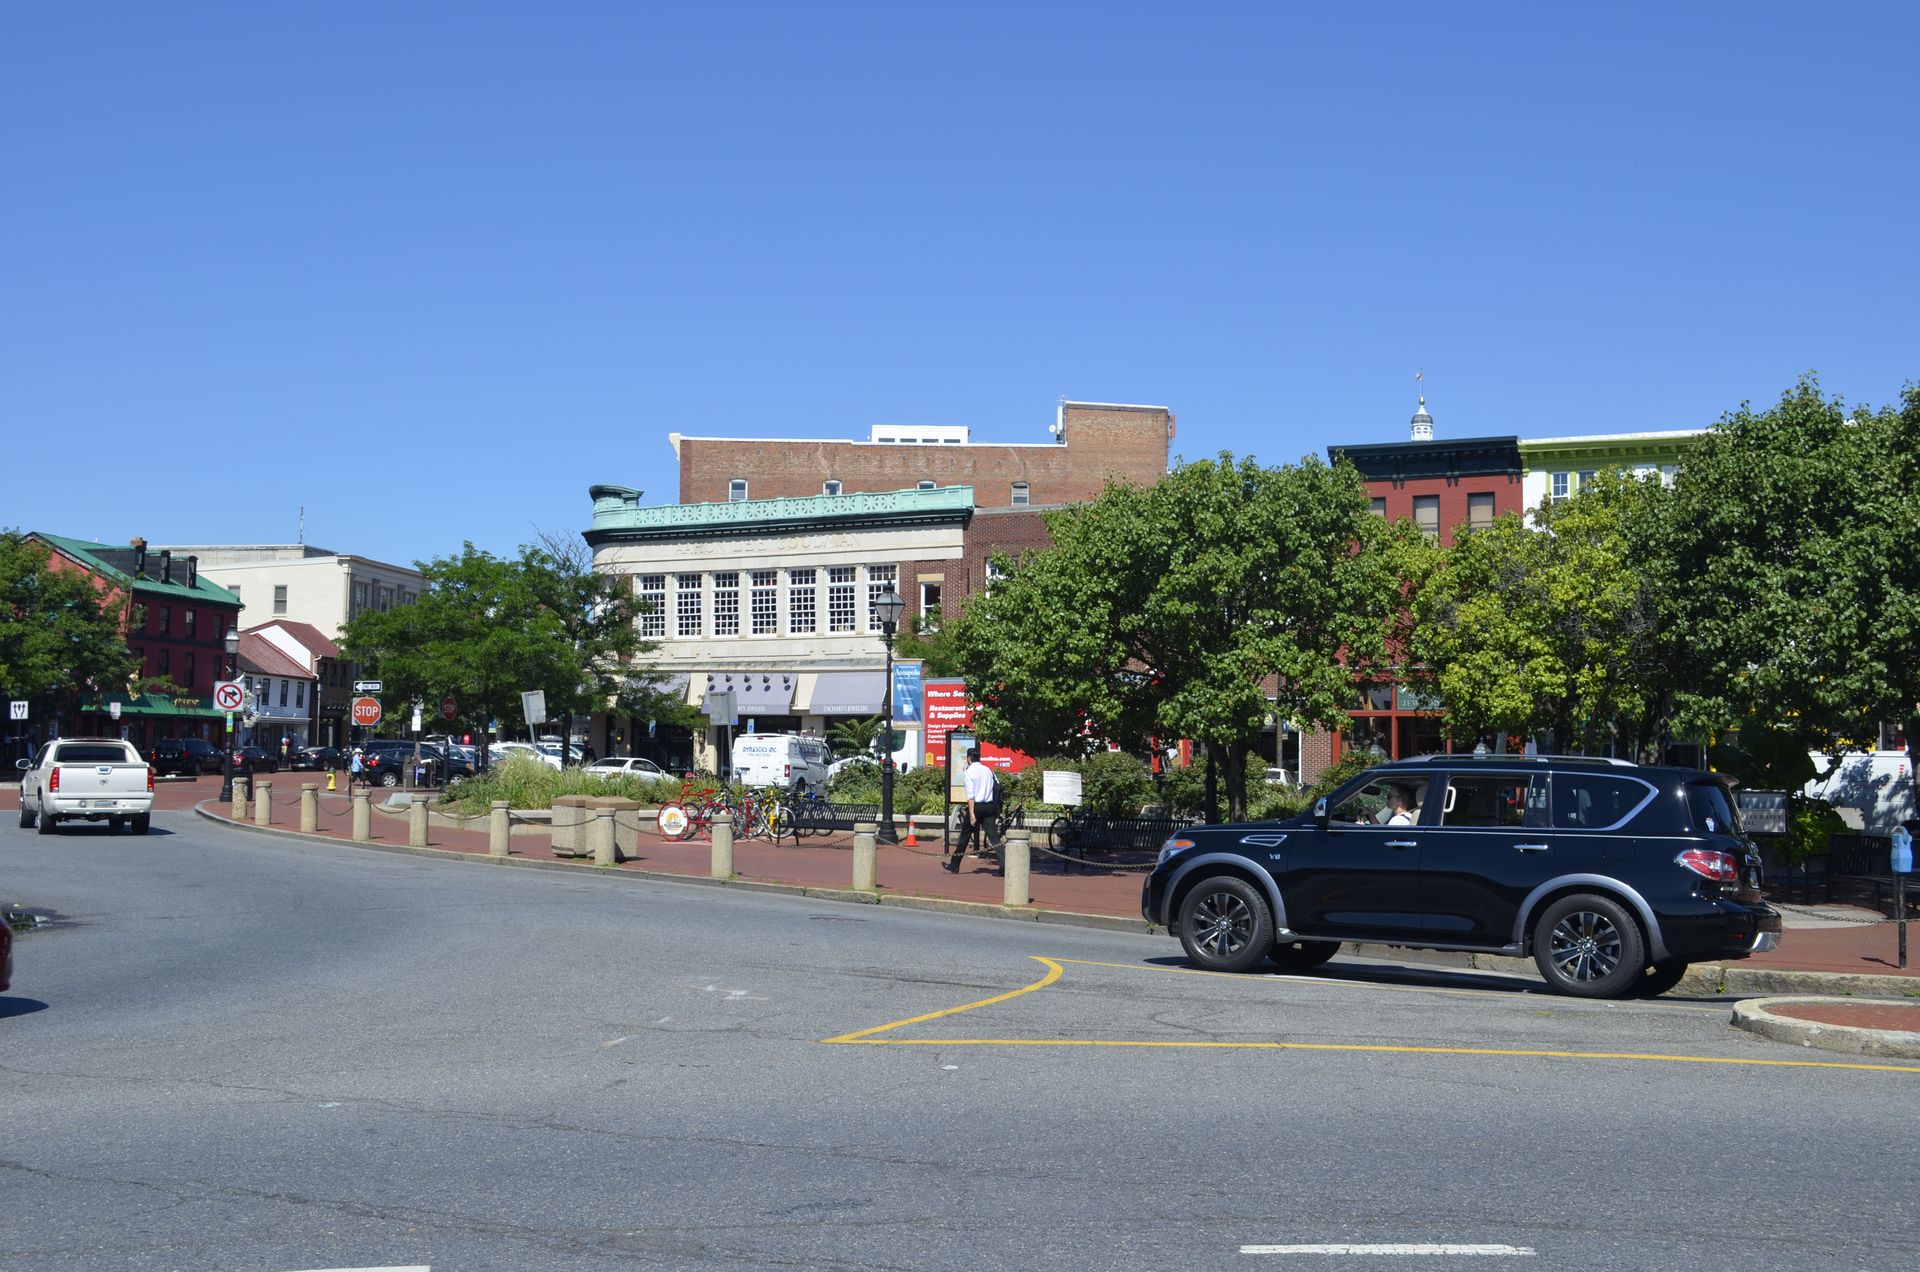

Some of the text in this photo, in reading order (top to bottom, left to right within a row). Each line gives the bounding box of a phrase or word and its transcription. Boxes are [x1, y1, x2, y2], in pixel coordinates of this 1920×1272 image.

[927, 690, 951, 698] Where
[355, 705, 379, 717] STOP
[929, 704, 966, 712] Restaurant
[937, 712, 966, 720] Supplies
